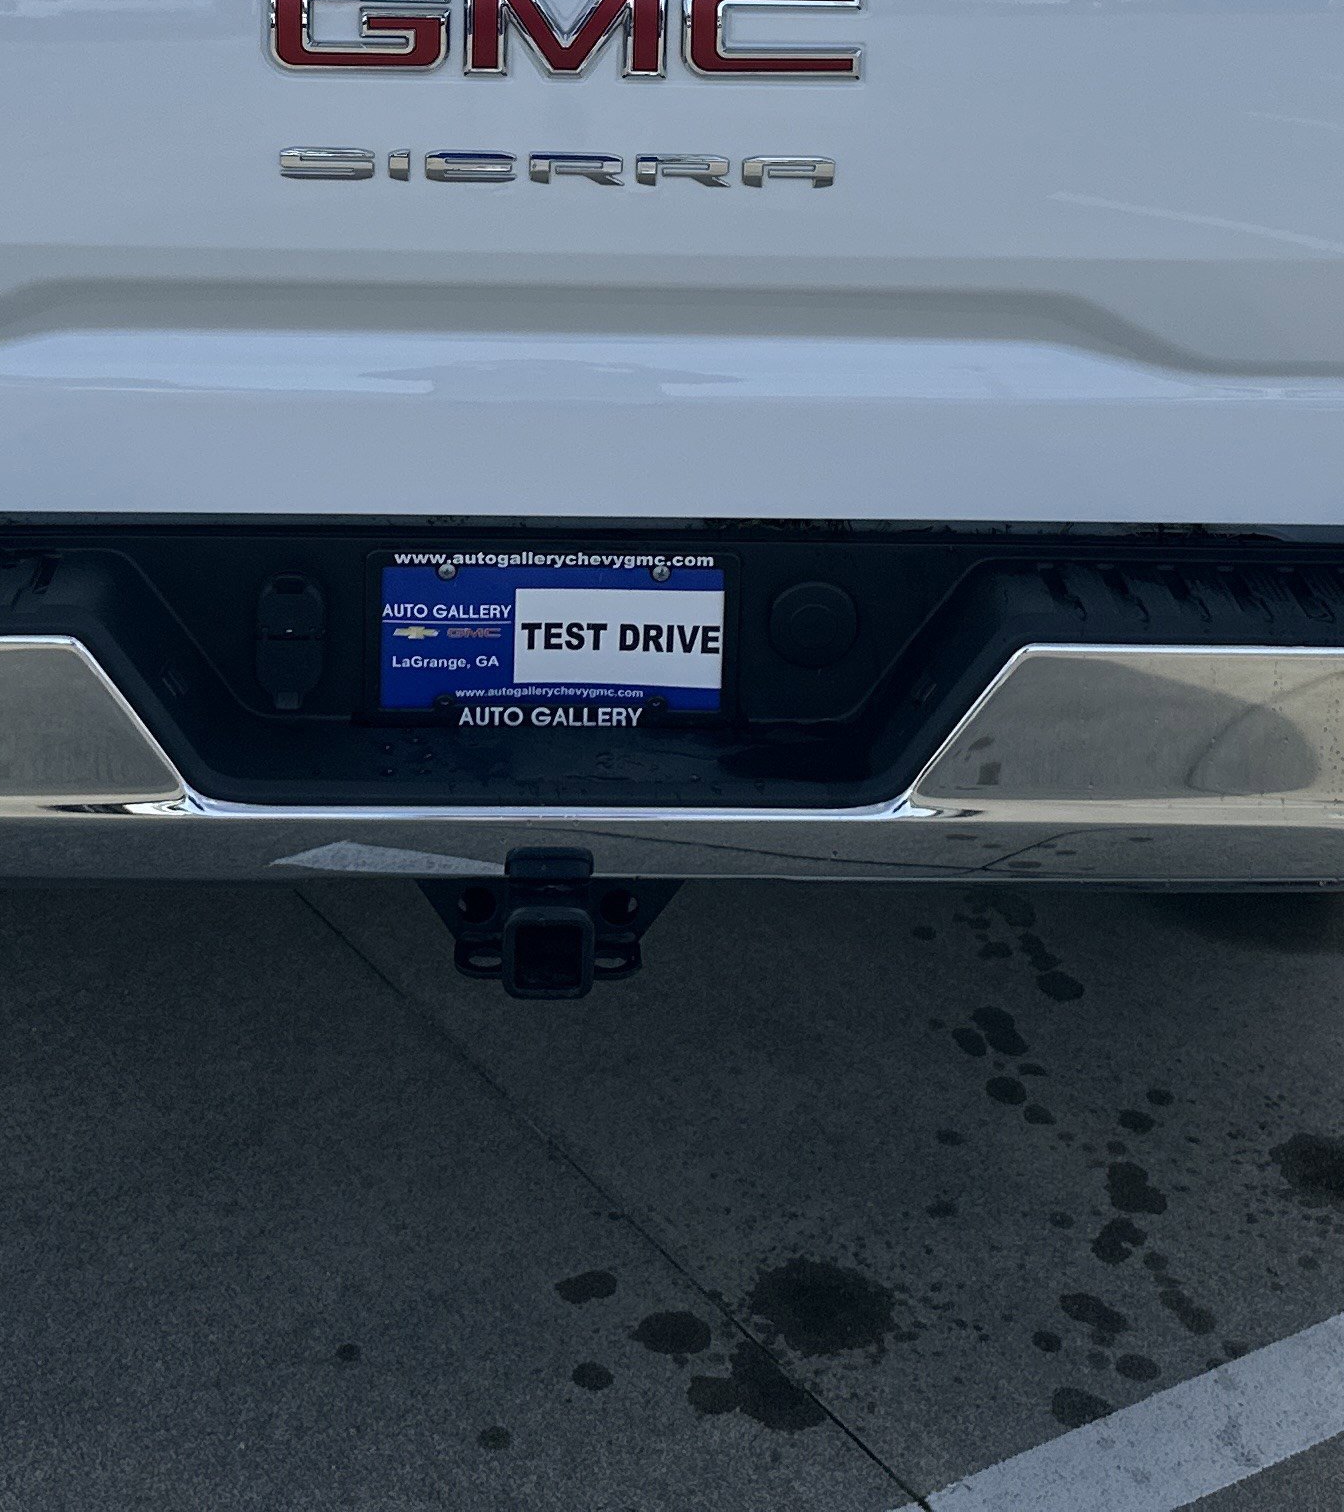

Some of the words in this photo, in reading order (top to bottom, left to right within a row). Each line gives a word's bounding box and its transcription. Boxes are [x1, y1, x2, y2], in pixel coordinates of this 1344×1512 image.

[279, 146, 837, 188] SIERRA
[394, 552, 714, 569] www.autogallerychevygmc.com
[382, 604, 428, 618] AUTO
[432, 605, 511, 619] GALLERY
[447, 628, 502, 638] GMC
[521, 621, 608, 651] TEST
[619, 623, 721, 654] DRIVE
[392, 655, 471, 670] LaGrange,
[476, 655, 499, 668] GA
[455, 686, 644, 699] www.autogallerychevygmc.com
[458, 707, 523, 726] AUTO
[531, 707, 643, 728] GALLERY
